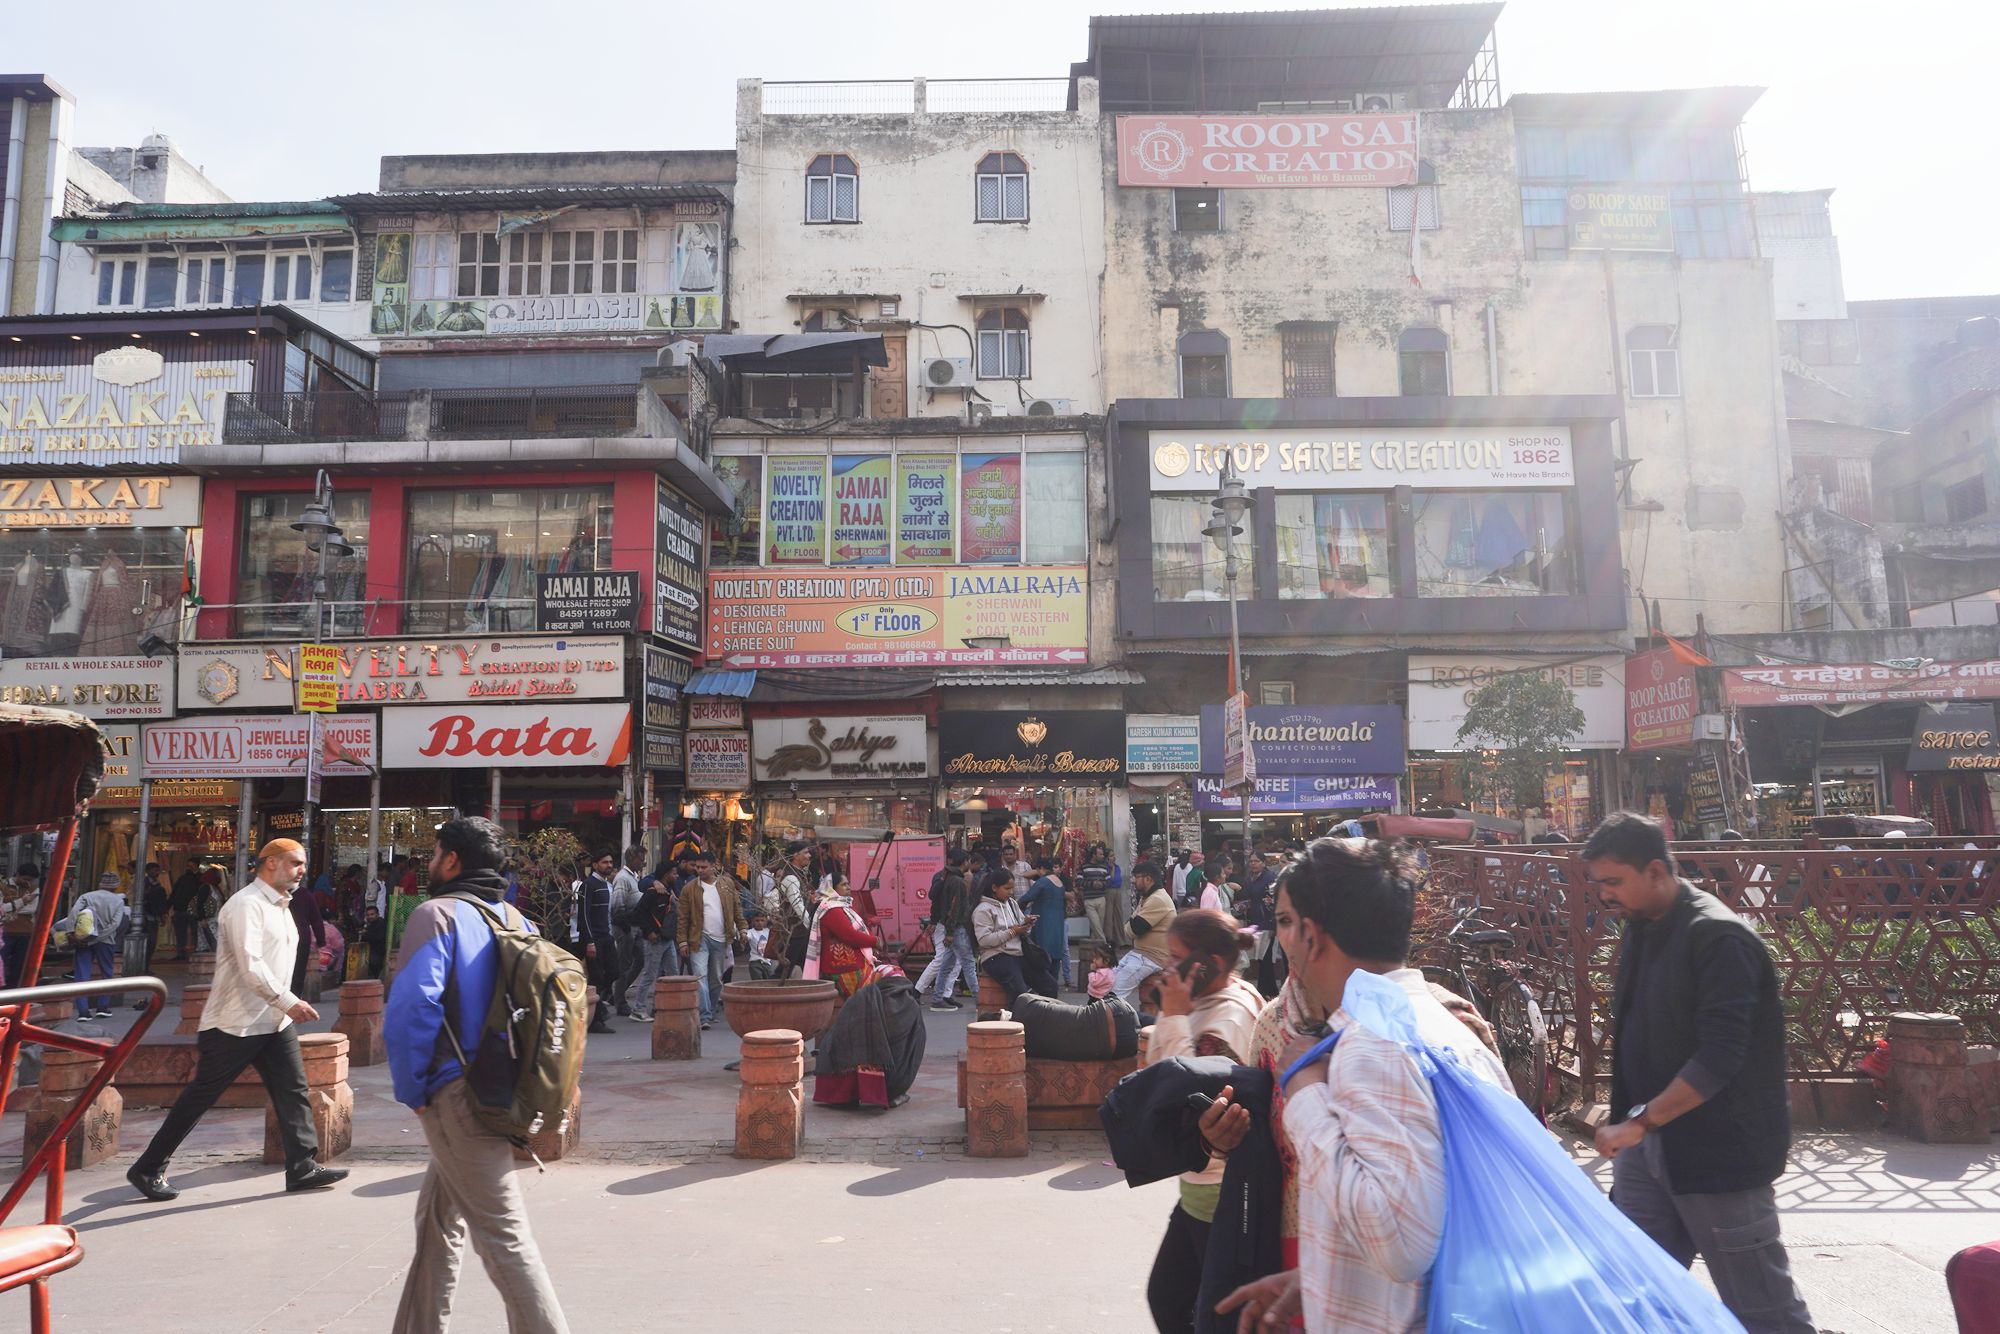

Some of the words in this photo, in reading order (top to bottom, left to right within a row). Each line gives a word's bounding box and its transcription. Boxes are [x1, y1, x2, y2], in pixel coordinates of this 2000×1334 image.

[1201, 122, 1330, 148] ROOP
[1256, 174, 1274, 183] We
[1278, 174, 1308, 183] Have
[1312, 174, 1328, 183] No
[1332, 172, 1376, 182] Branch
[1588, 194, 1625, 209] ROOP
[1628, 194, 1666, 210] SAREE
[378, 218, 412, 228] KAILASH
[1600, 213, 1656, 228] CREATION
[517, 296, 640, 321] KAILASH
[491, 322, 556, 333] DESIGNER
[561, 320, 639, 331] COLLECTION
[44, 432, 140, 452] BRIDAL
[1509, 438, 1540, 446] SHOP
[1544, 438, 1564, 446] NO.
[1280, 442, 1364, 474] SAREE
[1370, 440, 1502, 472] CREATION
[1514, 450, 1560, 464] 1862
[908, 473, 945, 490] मिलते
[979, 468, 1002, 483] हमारी
[773, 475, 822, 496] NOVELTY
[836, 477, 888, 499] JAMAI
[966, 488, 988, 499] अन्दर
[989, 486, 1008, 499] गली
[2, 478, 171, 510] ZAKAT
[908, 491, 944, 512] जुलते
[74, 512, 132, 524] STORE
[770, 500, 824, 521] CREATION
[840, 503, 884, 526] RAJA
[902, 510, 936, 526] नामों
[938, 511, 950, 526] से
[968, 502, 986, 517] कोई
[987, 504, 1012, 520] दुकान
[658, 503, 680, 534] NOVELTY
[777, 526, 794, 542] PVT.
[797, 526, 816, 542] LTD.
[834, 529, 887, 540] SHERWANI
[900, 529, 951, 541] सावधान
[667, 532, 695, 563] CHABRA
[794, 548, 820, 557] FLOOR
[658, 552, 682, 584] JAMAI
[682, 563, 702, 593] RAJA
[544, 577, 588, 598] JAMAI
[594, 576, 631, 597] RAJA
[714, 579, 774, 599] NOVELTY
[776, 578, 846, 599] CREATION
[850, 578, 890, 599] (PVT.)
[894, 577, 934, 598] (LTD.)
[951, 576, 1020, 598] JAMAI
[1026, 576, 1081, 598] RAJA
[546, 600, 588, 608] WHOLESALE
[612, 598, 631, 607] SHOP
[664, 585, 676, 599] 1st
[677, 588, 694, 606] Floor
[724, 605, 786, 618] DESIGNER
[880, 606, 894, 614] Only
[976, 599, 1042, 609] SHERWANI
[560, 610, 617, 618] 8459112897
[976, 612, 1006, 622] INDO
[1010, 612, 1070, 622] WESTERN
[545, 622, 550, 630] 8
[551, 622, 568, 630] कदम
[570, 620, 584, 630] आगे
[592, 621, 603, 629] 1st
[606, 620, 631, 628] FLOOR
[724, 621, 773, 634] LEHNGA
[777, 620, 825, 633] CHUNNI
[874, 614, 921, 632] FLOOR
[976, 626, 1008, 636] COAT
[1012, 626, 1046, 636] PAINT
[724, 637, 763, 651] SAREE
[767, 636, 796, 650] SUIT
[845, 642, 878, 650] Contact
[884, 640, 936, 649] 9810668426
[302, 647, 337, 658] JAMAI
[760, 655, 777, 667] 8,
[784, 655, 800, 664] 10
[805, 654, 848, 664] कदम
[852, 652, 891, 663] आगे
[894, 650, 928, 662] जीने
[933, 650, 946, 662] में
[952, 649, 994, 661] पहली
[26, 662, 60, 670] RETAIL
[62, 662, 70, 670] &
[72, 661, 108, 670] WHOLE
[111, 661, 135, 669] SALE
[137, 660, 163, 668] SHOP
[262, 644, 481, 680] NVELTY
[305, 660, 334, 671] RAJA
[479, 661, 560, 674] CREATION
[562, 659, 581, 672] (P)
[586, 660, 619, 672] LTD.
[1740, 670, 1786, 685] न्यू
[1790, 665, 1864, 682] महेश
[73, 684, 161, 704] STORE
[336, 682, 426, 703] HABRA
[468, 679, 520, 697] Bridal
[523, 678, 576, 696] Studio
[1630, 687, 1656, 709] ROOP
[1657, 679, 1692, 703] SAREE
[1776, 693, 1829, 702] आपका
[1888, 689, 1947, 699] स्वागत
[1952, 687, 1966, 698] है
[647, 702, 675, 726] CHABRA
[1634, 703, 1690, 728] CREATION
[327, 729, 371, 744] HOUSE
[418, 715, 597, 757] Bata
[1129, 728, 1152, 737] NARESH
[1153, 728, 1173, 736] KUMAR
[1173, 727, 1196, 736] KHANNA
[1249, 721, 1373, 742] hantewala
[150, 732, 236, 760] VERMA
[690, 739, 720, 752] POOJA
[722, 739, 747, 752] STORE
[1920, 731, 1991, 749] saree
[247, 750, 272, 760] 1856
[946, 753, 1048, 773] Anarkali
[1049, 751, 1120, 773] Bazar
[831, 763, 878, 774] BRIDAL
[879, 762, 926, 773] WEARS
[1314, 776, 1377, 791] GHUJIA
[107, 787, 132, 798] THE
[183, 786, 223, 796] STORE
[1264, 795, 1276, 804] Kg
[1300, 795, 1325, 803] Starting
[1326, 793, 1342, 802] From
[1343, 792, 1354, 800] Rs.
[1382, 792, 1392, 801] Kg
